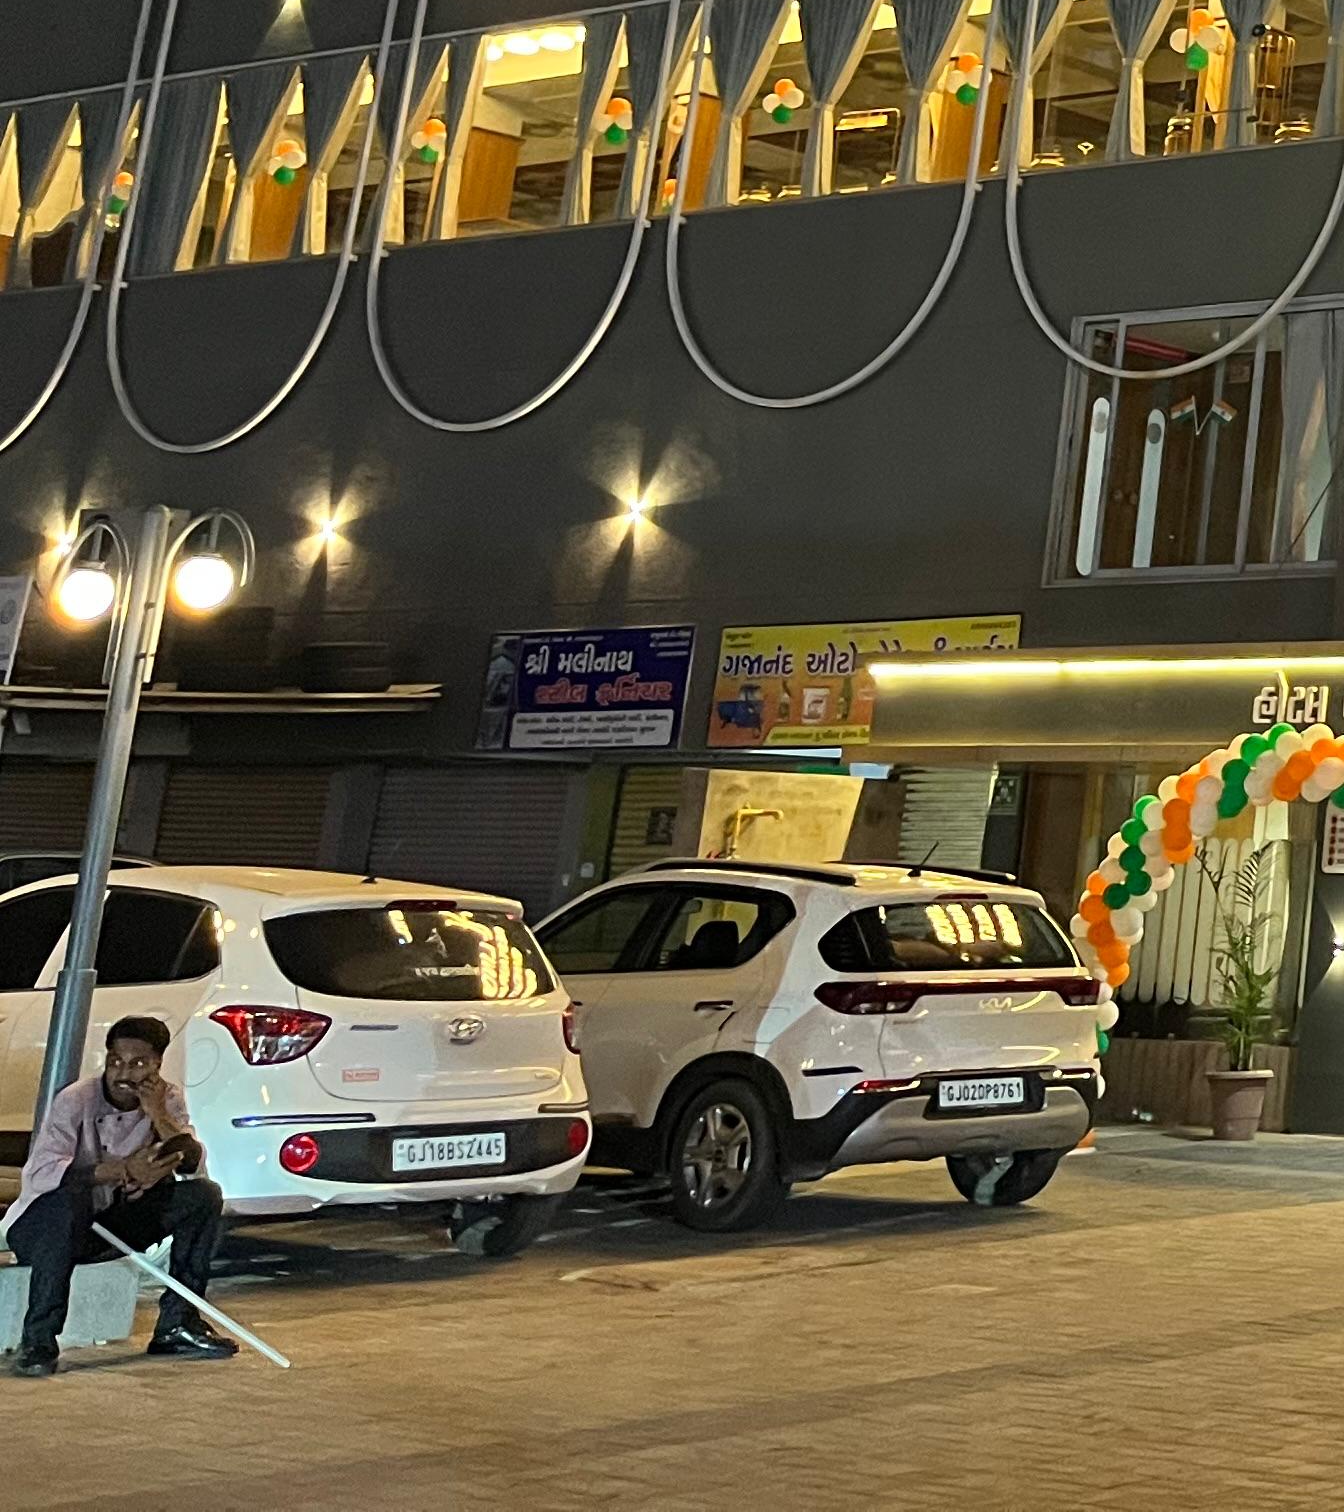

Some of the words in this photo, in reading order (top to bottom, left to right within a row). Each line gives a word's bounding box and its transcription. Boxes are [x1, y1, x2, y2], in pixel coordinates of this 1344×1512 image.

[525, 645, 550, 675] શ્રી
[722, 644, 793, 676] ગજાનંદ
[1252, 669, 1329, 724] હોટલ
